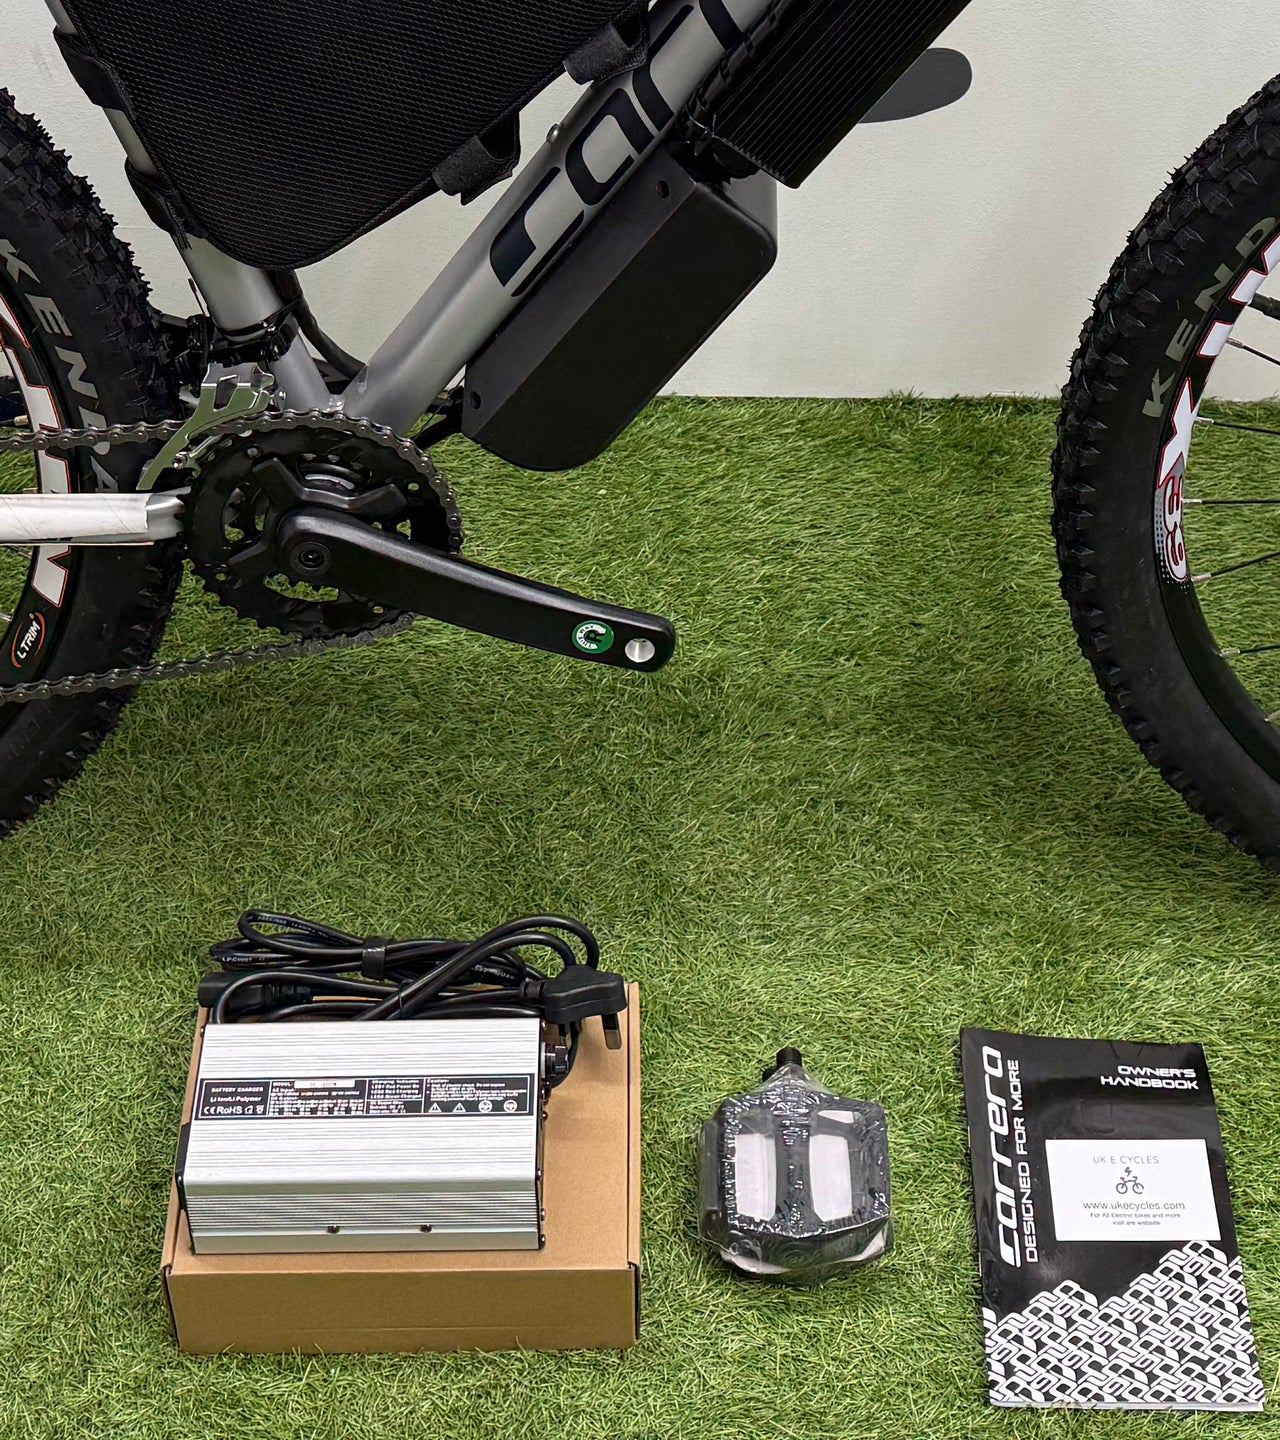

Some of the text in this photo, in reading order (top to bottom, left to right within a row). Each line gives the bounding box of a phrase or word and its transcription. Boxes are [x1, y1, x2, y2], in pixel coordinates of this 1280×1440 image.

[1117, 1065, 1196, 1078] OWNER'S
[1100, 1075, 1199, 1090] HANDBOOK
[216, 1106, 243, 1114] RoHS
[982, 1045, 1021, 1268] carrera
[1007, 1059, 1039, 1263] DESIGNED FOR MORE
[1093, 1156, 1106, 1164] UK
[1120, 1155, 1159, 1164] CYCLES
[1083, 1201, 1185, 1211] www.ukecycles.com
